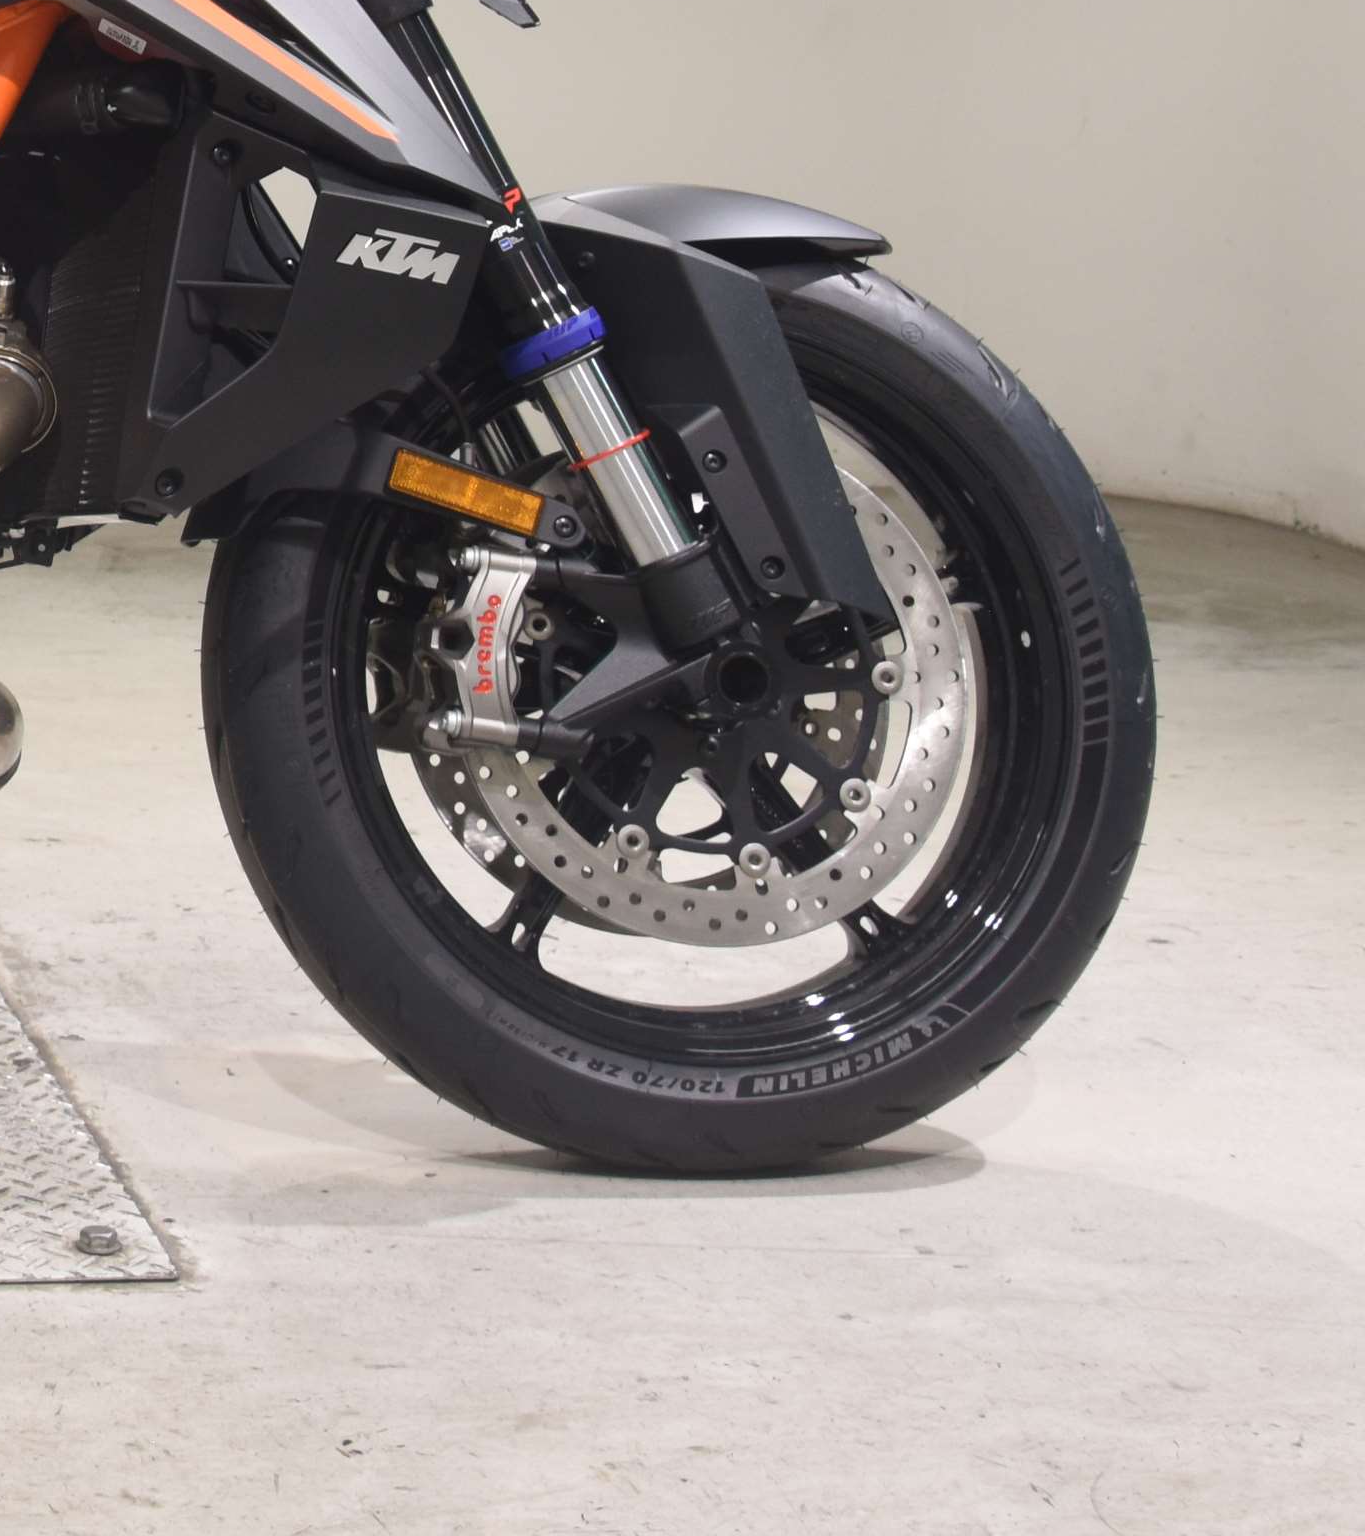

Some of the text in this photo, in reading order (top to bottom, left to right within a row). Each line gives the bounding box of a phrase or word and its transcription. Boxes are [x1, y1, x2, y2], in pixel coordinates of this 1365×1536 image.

[335, 227, 461, 285] KTM
[473, 594, 502, 695] brembo
[550, 1045, 579, 1063] 17
[586, 1056, 624, 1078] ZR
[752, 1031, 914, 1094] MICHELIN
[631, 1070, 727, 1094] 120/70
